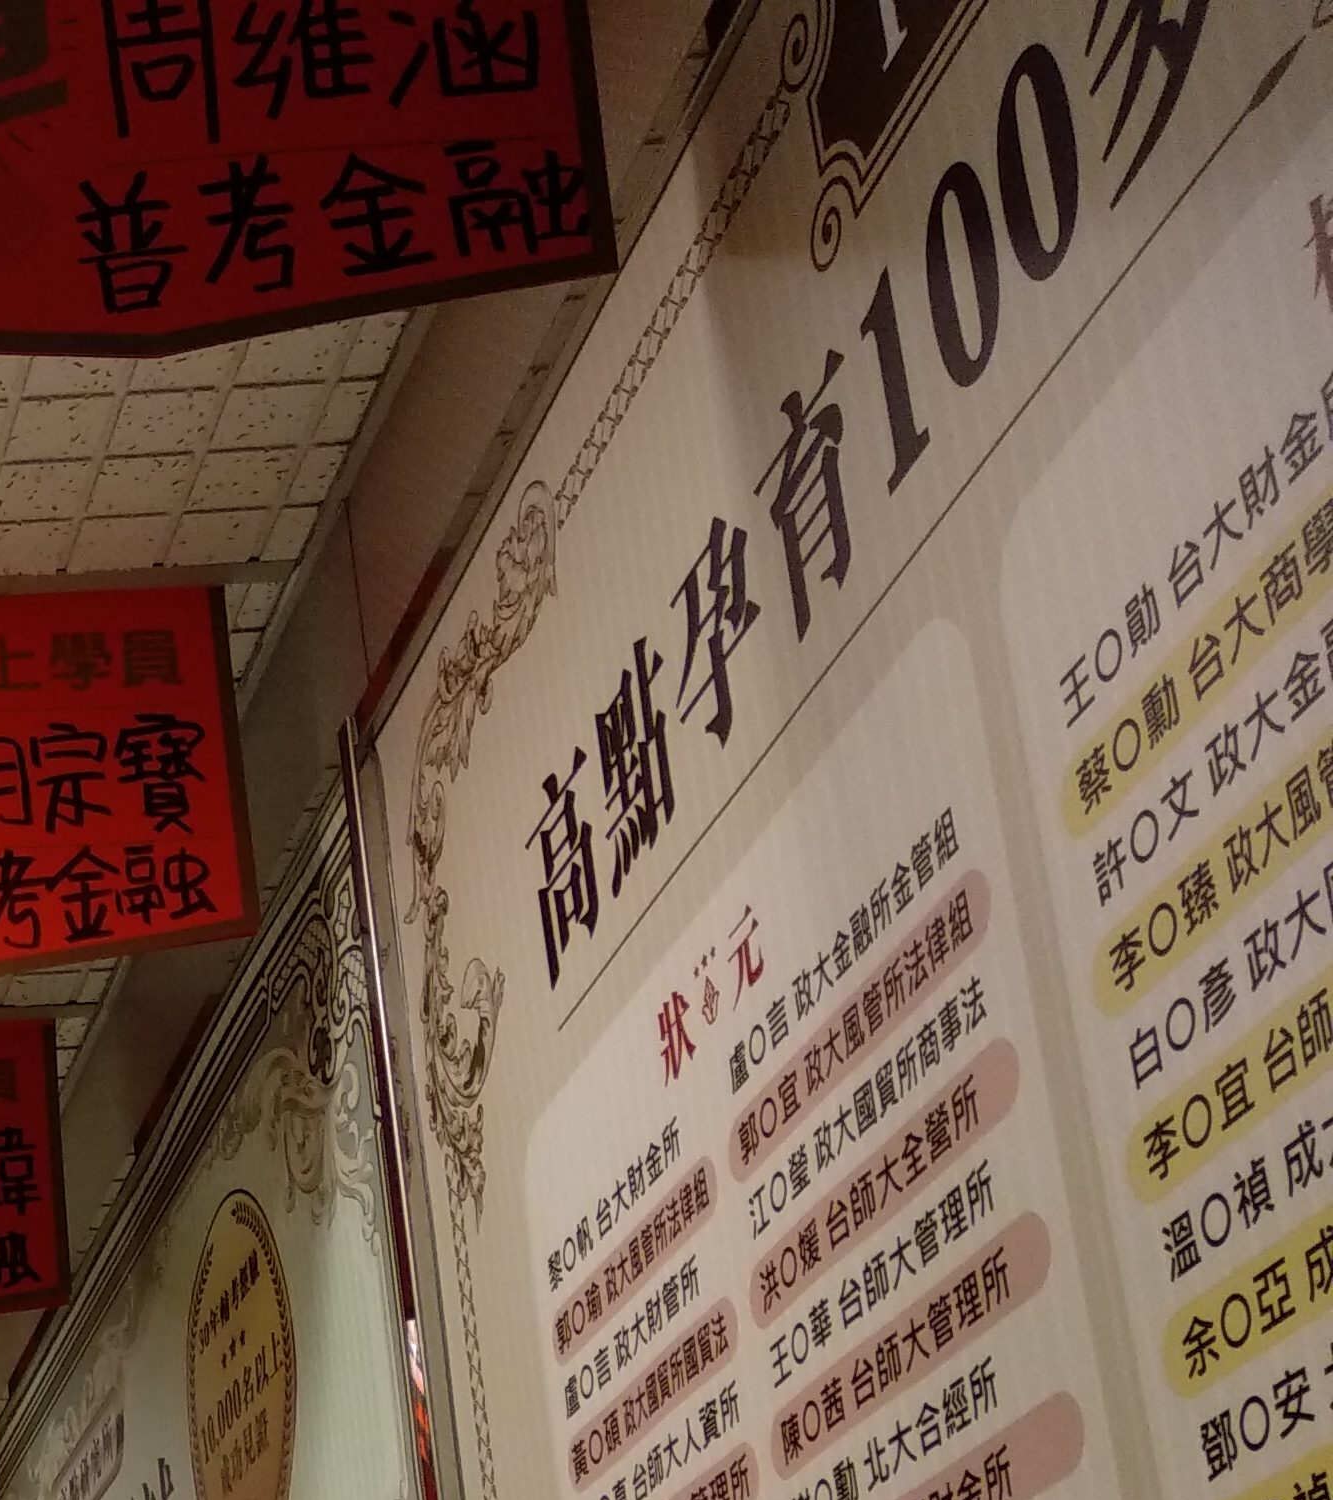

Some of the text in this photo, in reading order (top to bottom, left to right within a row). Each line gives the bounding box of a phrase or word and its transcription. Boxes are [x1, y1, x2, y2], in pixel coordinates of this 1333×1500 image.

[105, 0, 539, 142] 周維涵
[76, 140, 589, 313] 普考金融
[792, 806, 960, 1023] 政大金融所金管組
[804, 889, 974, 1097] 政大風管所法律組
[813, 975, 988, 1173] 政大國貿所商事法
[595, 1115, 681, 1240] 台大財金所
[825, 1074, 980, 1250] 台師大全營所
[838, 1159, 994, 1329] 台師大管理所
[614, 1253, 700, 1371] 政大財管所
[850, 1246, 1011, 1410] 台師大管理所
[863, 1356, 999, 1492] 北大合經所
